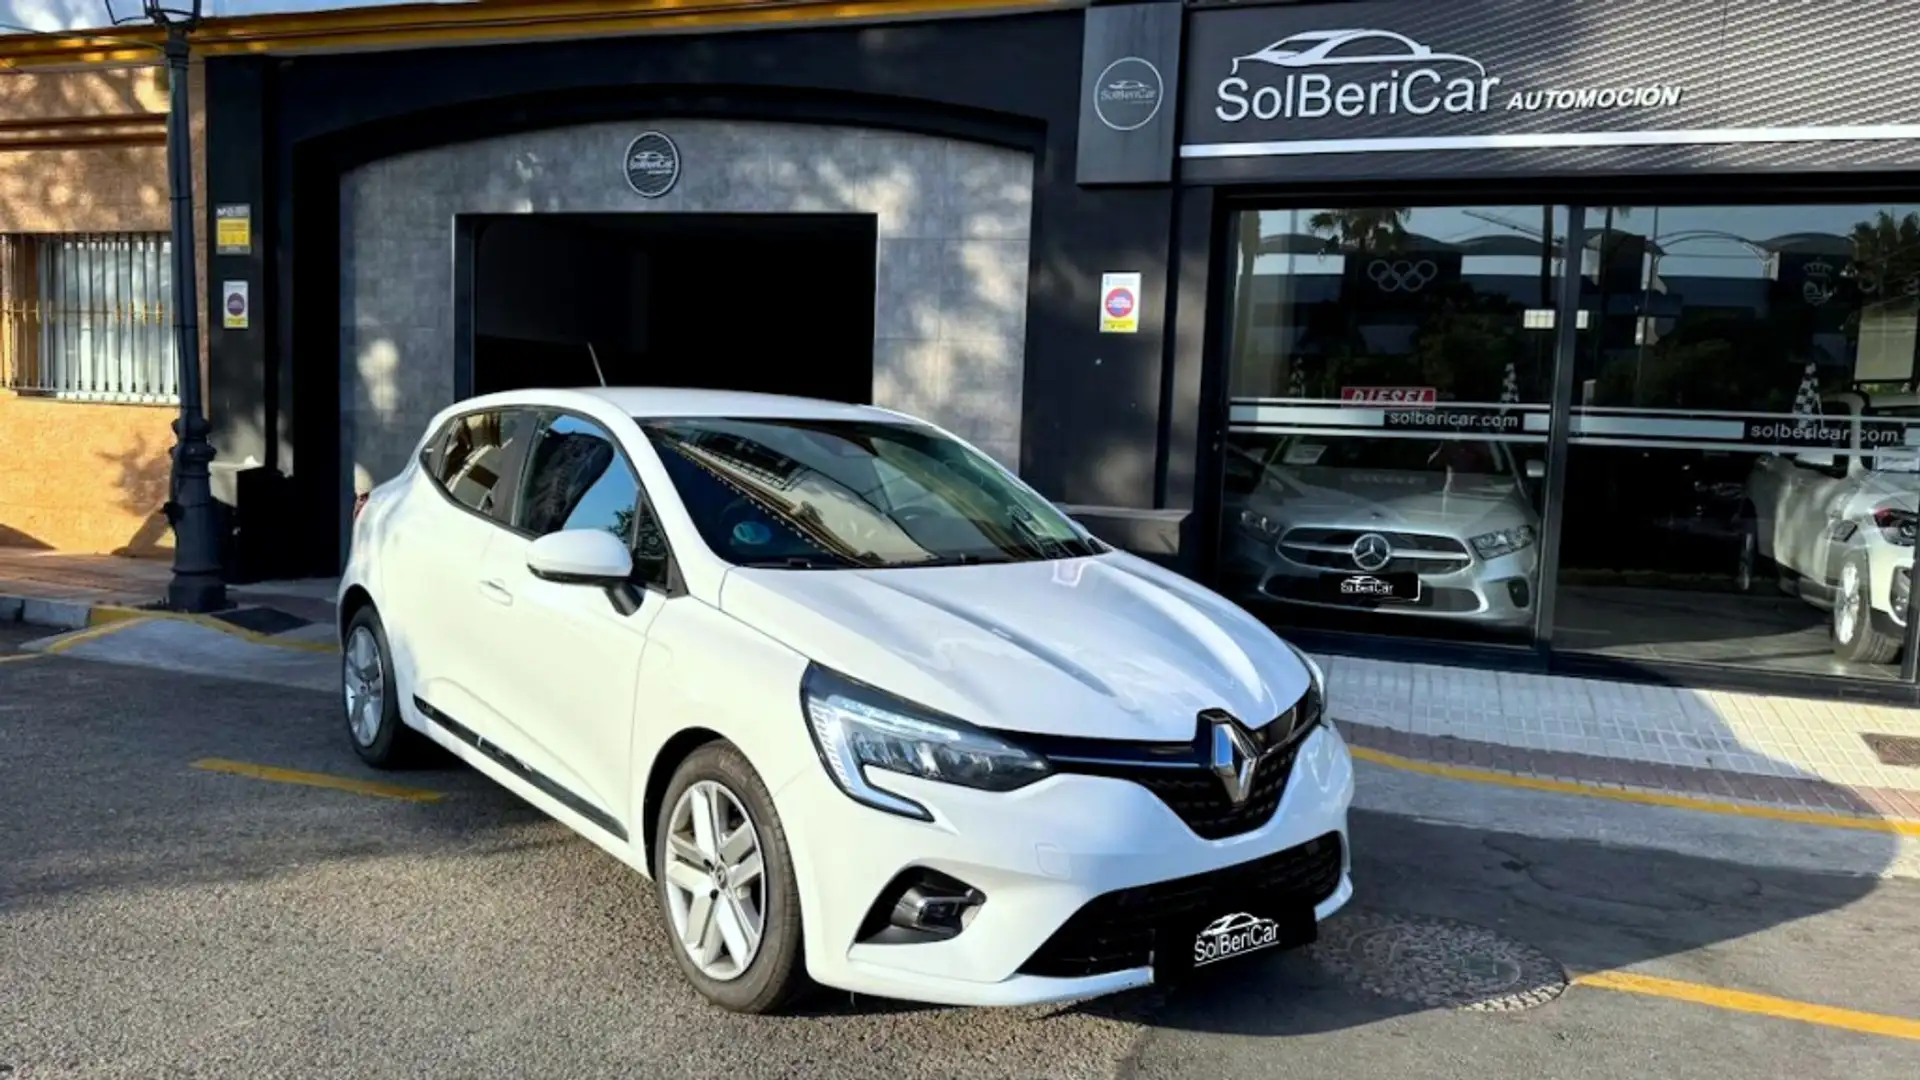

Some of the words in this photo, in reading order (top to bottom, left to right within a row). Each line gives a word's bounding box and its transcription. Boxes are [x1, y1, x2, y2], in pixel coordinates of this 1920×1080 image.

[1215, 69, 1500, 122] SolBeriCar
[1506, 84, 1682, 111] AUTOMOCIÓN
[1351, 388, 1427, 405] DIESEL
[1389, 411, 1519, 428] solbericar.com
[1193, 922, 1280, 962] SolBeriCar
